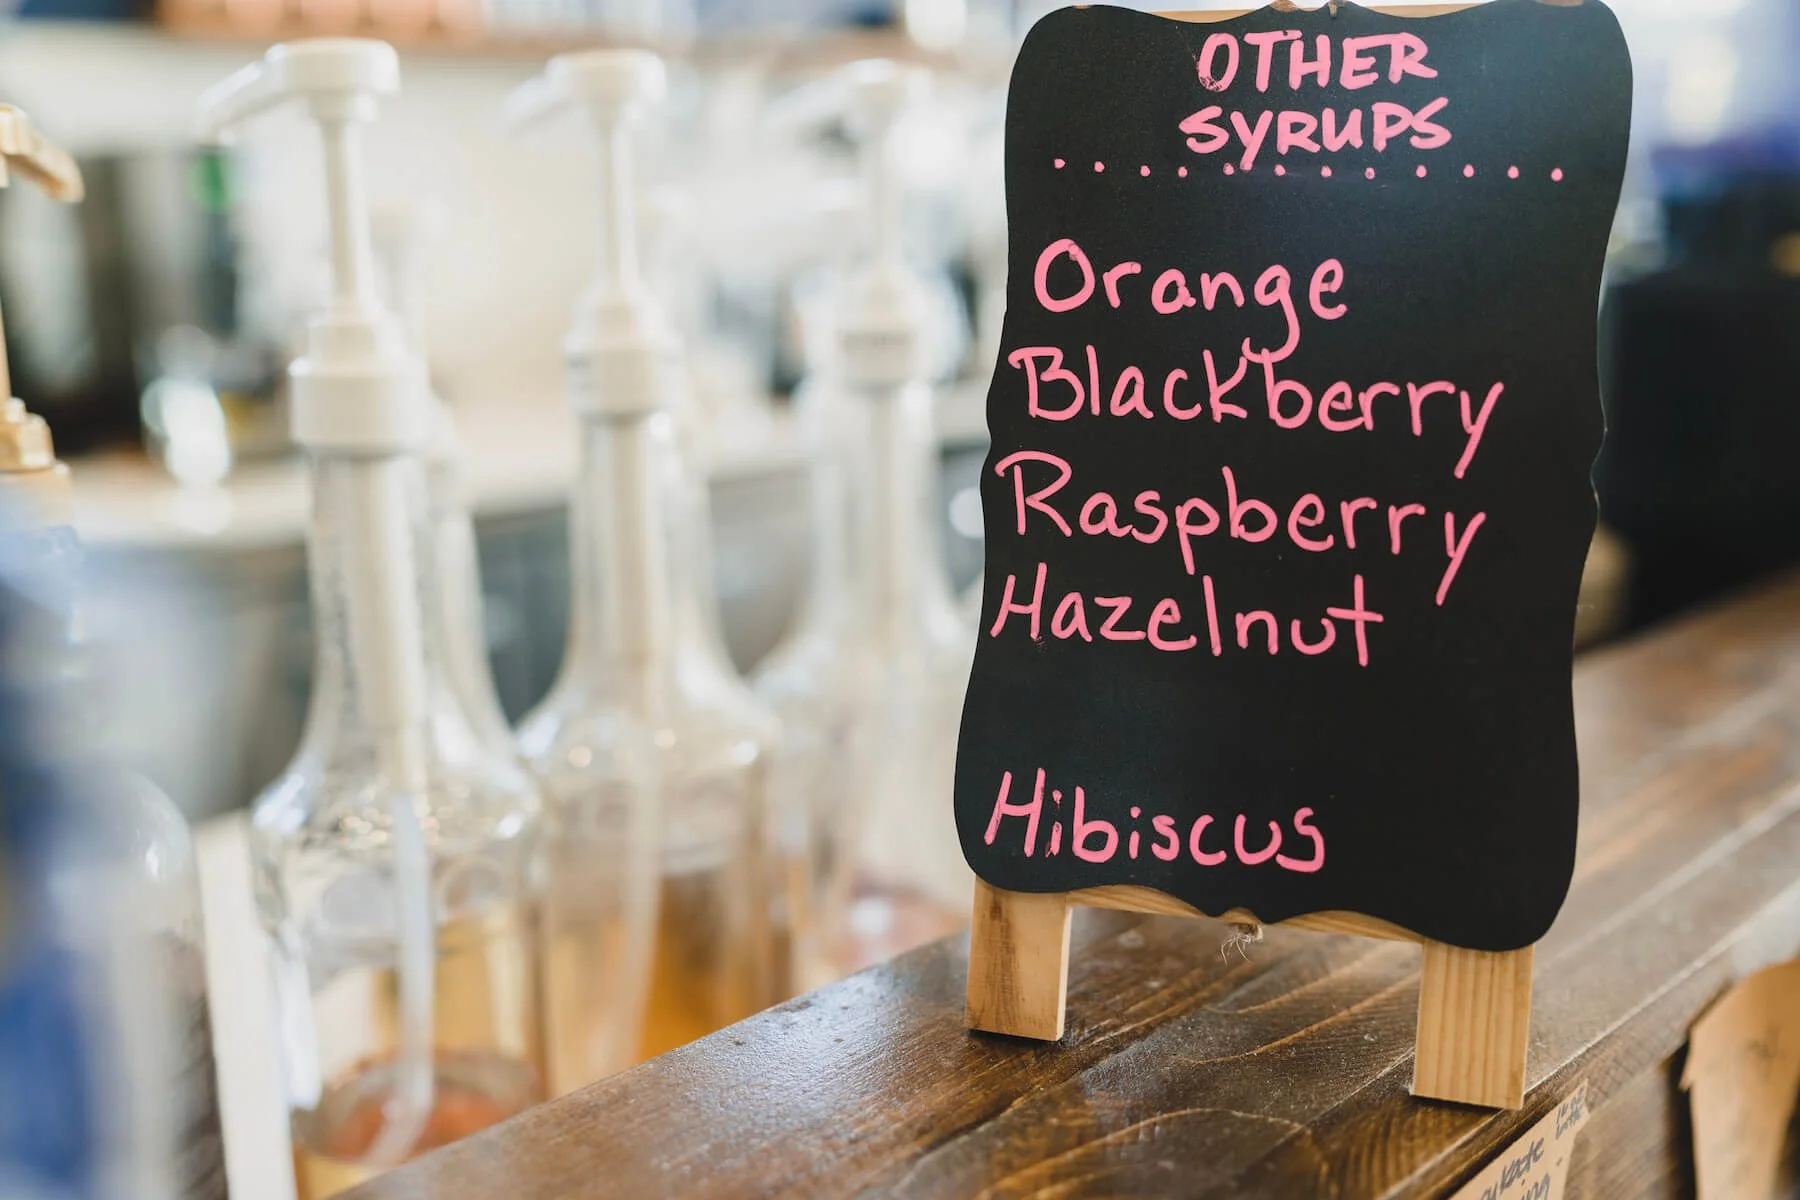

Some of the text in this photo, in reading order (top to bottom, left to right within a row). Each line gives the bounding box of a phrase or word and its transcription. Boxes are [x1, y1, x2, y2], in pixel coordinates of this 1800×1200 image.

[1197, 30, 1439, 92] OTHER
[1179, 97, 1451, 171] SYRUPS
[1033, 237, 1347, 363] Orange
[1007, 345, 1505, 480] Blackberry
[995, 450, 1487, 607] Raspberry
[990, 562, 1384, 667] Hazelnut
[984, 767, 1326, 874] Hibiscus
